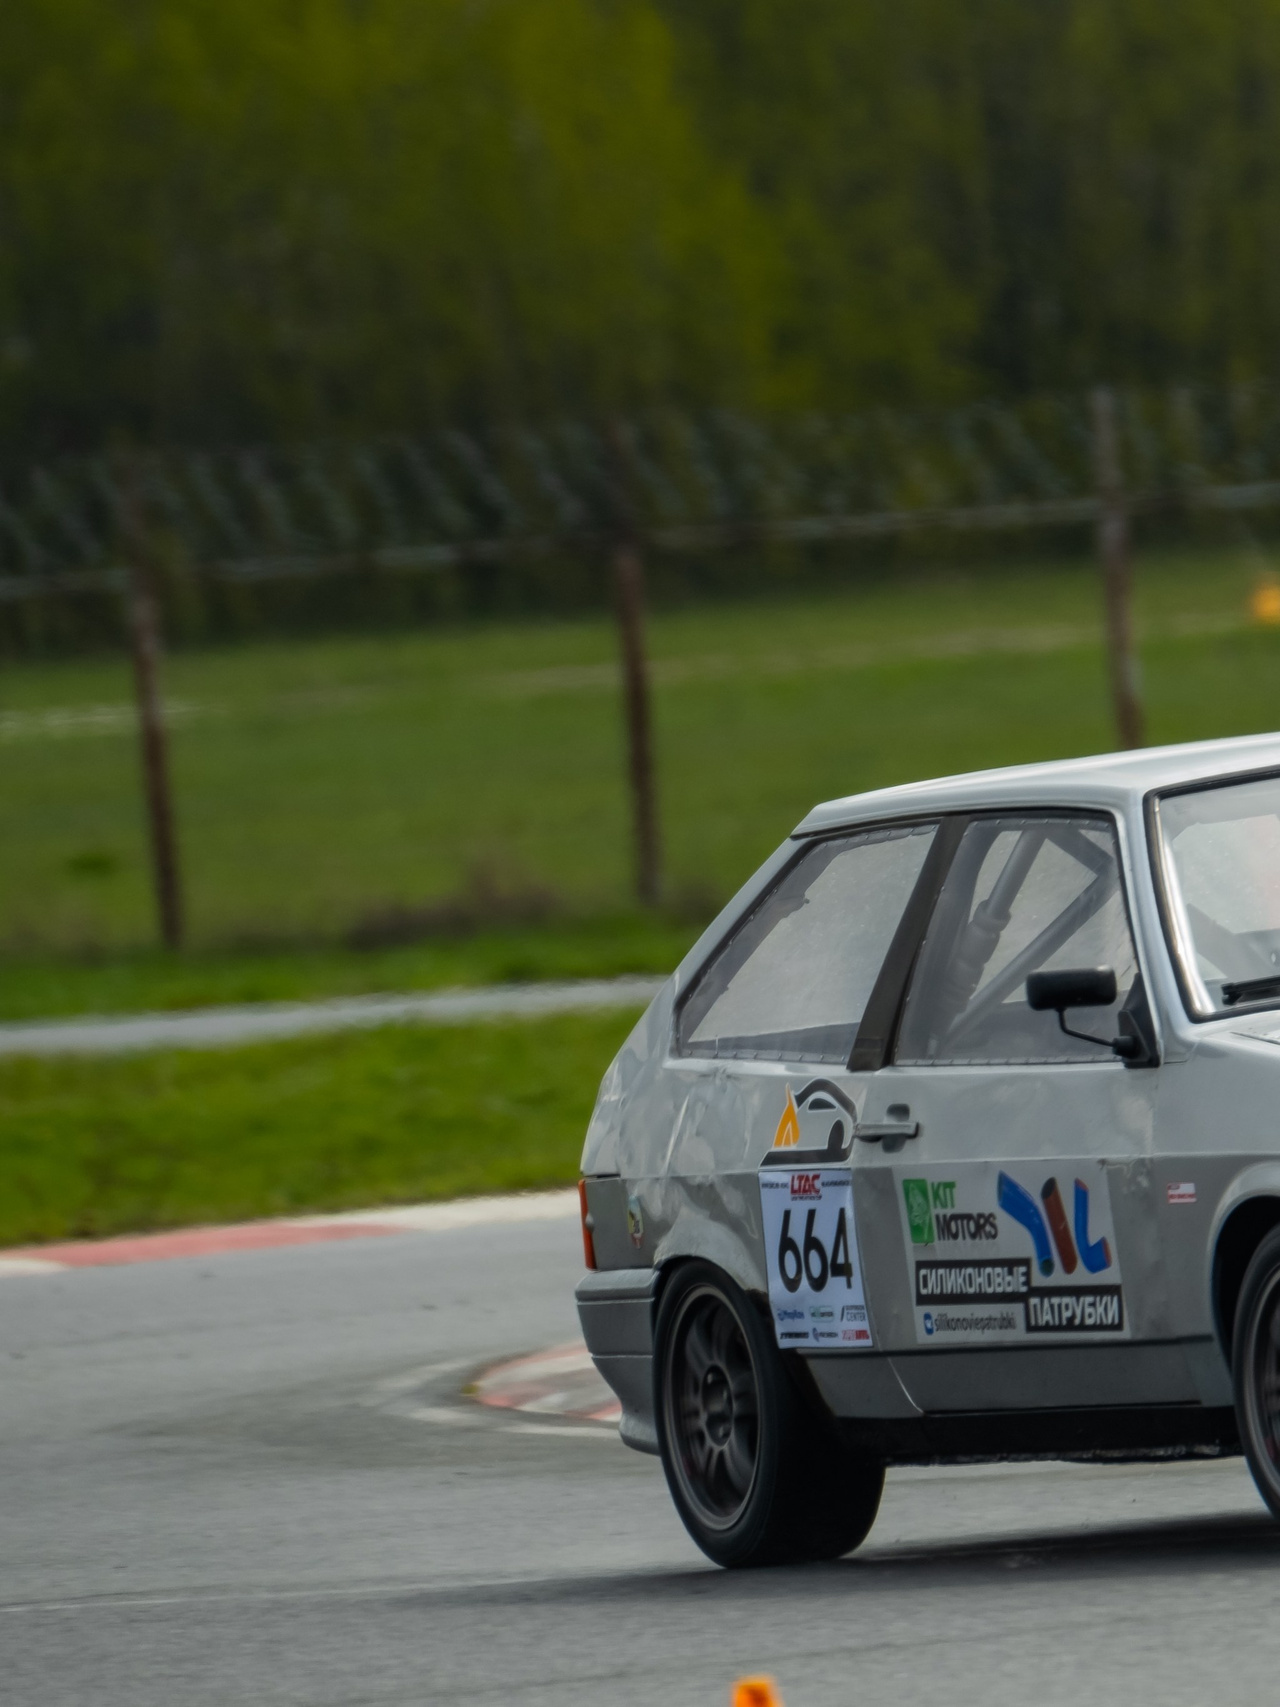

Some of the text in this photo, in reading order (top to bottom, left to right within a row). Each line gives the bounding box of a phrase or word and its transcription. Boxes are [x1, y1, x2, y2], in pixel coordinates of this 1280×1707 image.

[931, 1181, 957, 1209] KIT
[936, 1212, 999, 1242] MOTORS
[778, 1208, 852, 1293] 664
[919, 1266, 1028, 1295] СИЛИКОНОВЫЕ
[934, 1312, 1017, 1335] silikonoviepatrubki
[1030, 1293, 1119, 1328] ПАТРУБКИ
